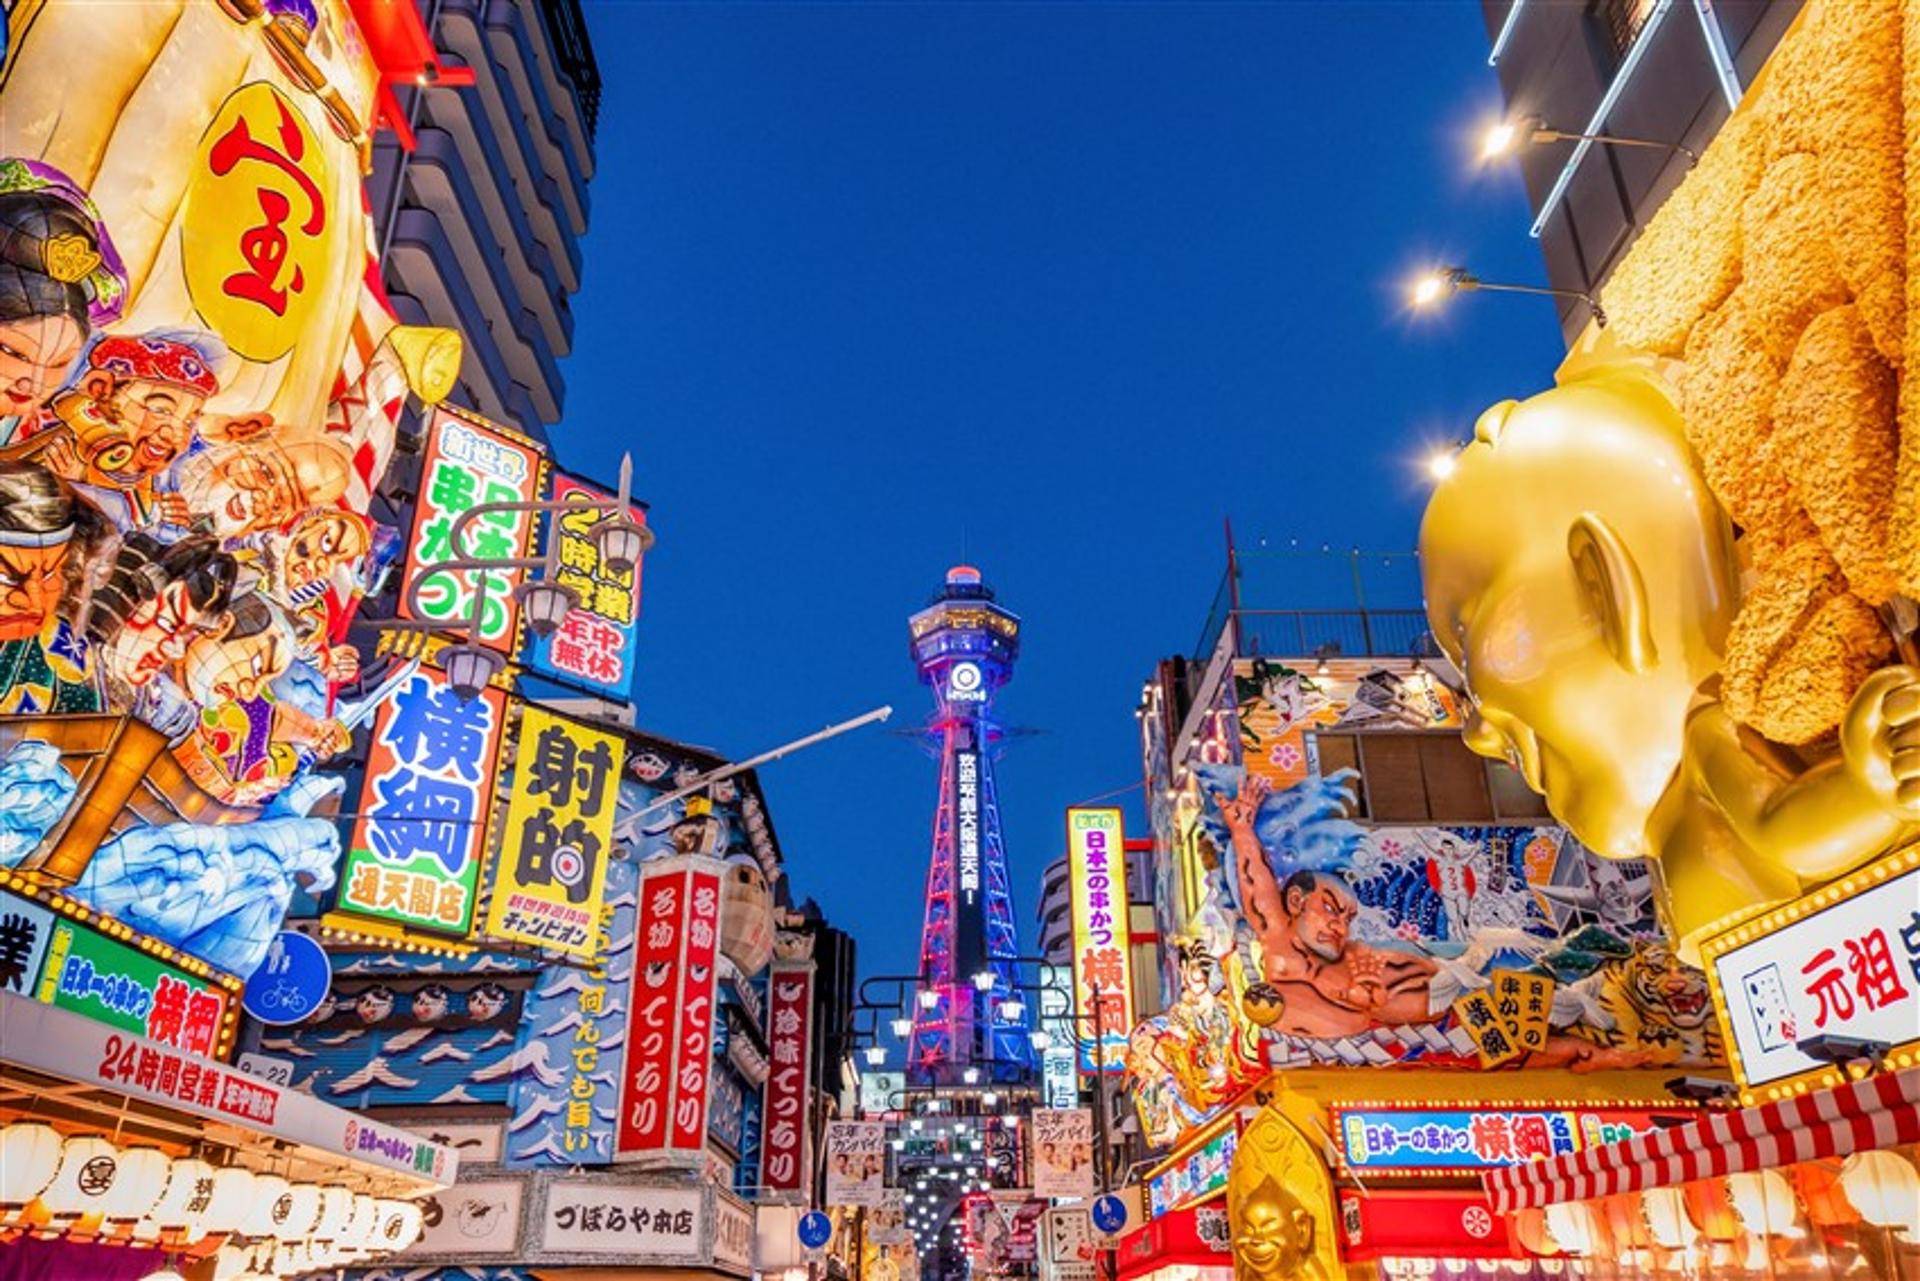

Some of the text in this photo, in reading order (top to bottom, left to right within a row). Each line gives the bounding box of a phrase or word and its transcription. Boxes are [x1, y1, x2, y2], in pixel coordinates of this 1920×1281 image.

[443, 426, 525, 483] 新世界
[418, 463, 475, 617] 串かつ
[370, 677, 489, 874] 横綱
[515, 725, 614, 903] 射的
[348, 865, 464, 922] 通天閣店
[648, 887, 676, 949] 名物
[690, 887, 716, 949] 名物
[1085, 830, 1113, 946] 日本一の串かつ
[99, 1034, 219, 1108] 24時間営業
[1366, 1126, 1470, 1152] 日本一の串かつ
[554, 1203, 694, 1235] づぼらや本店
